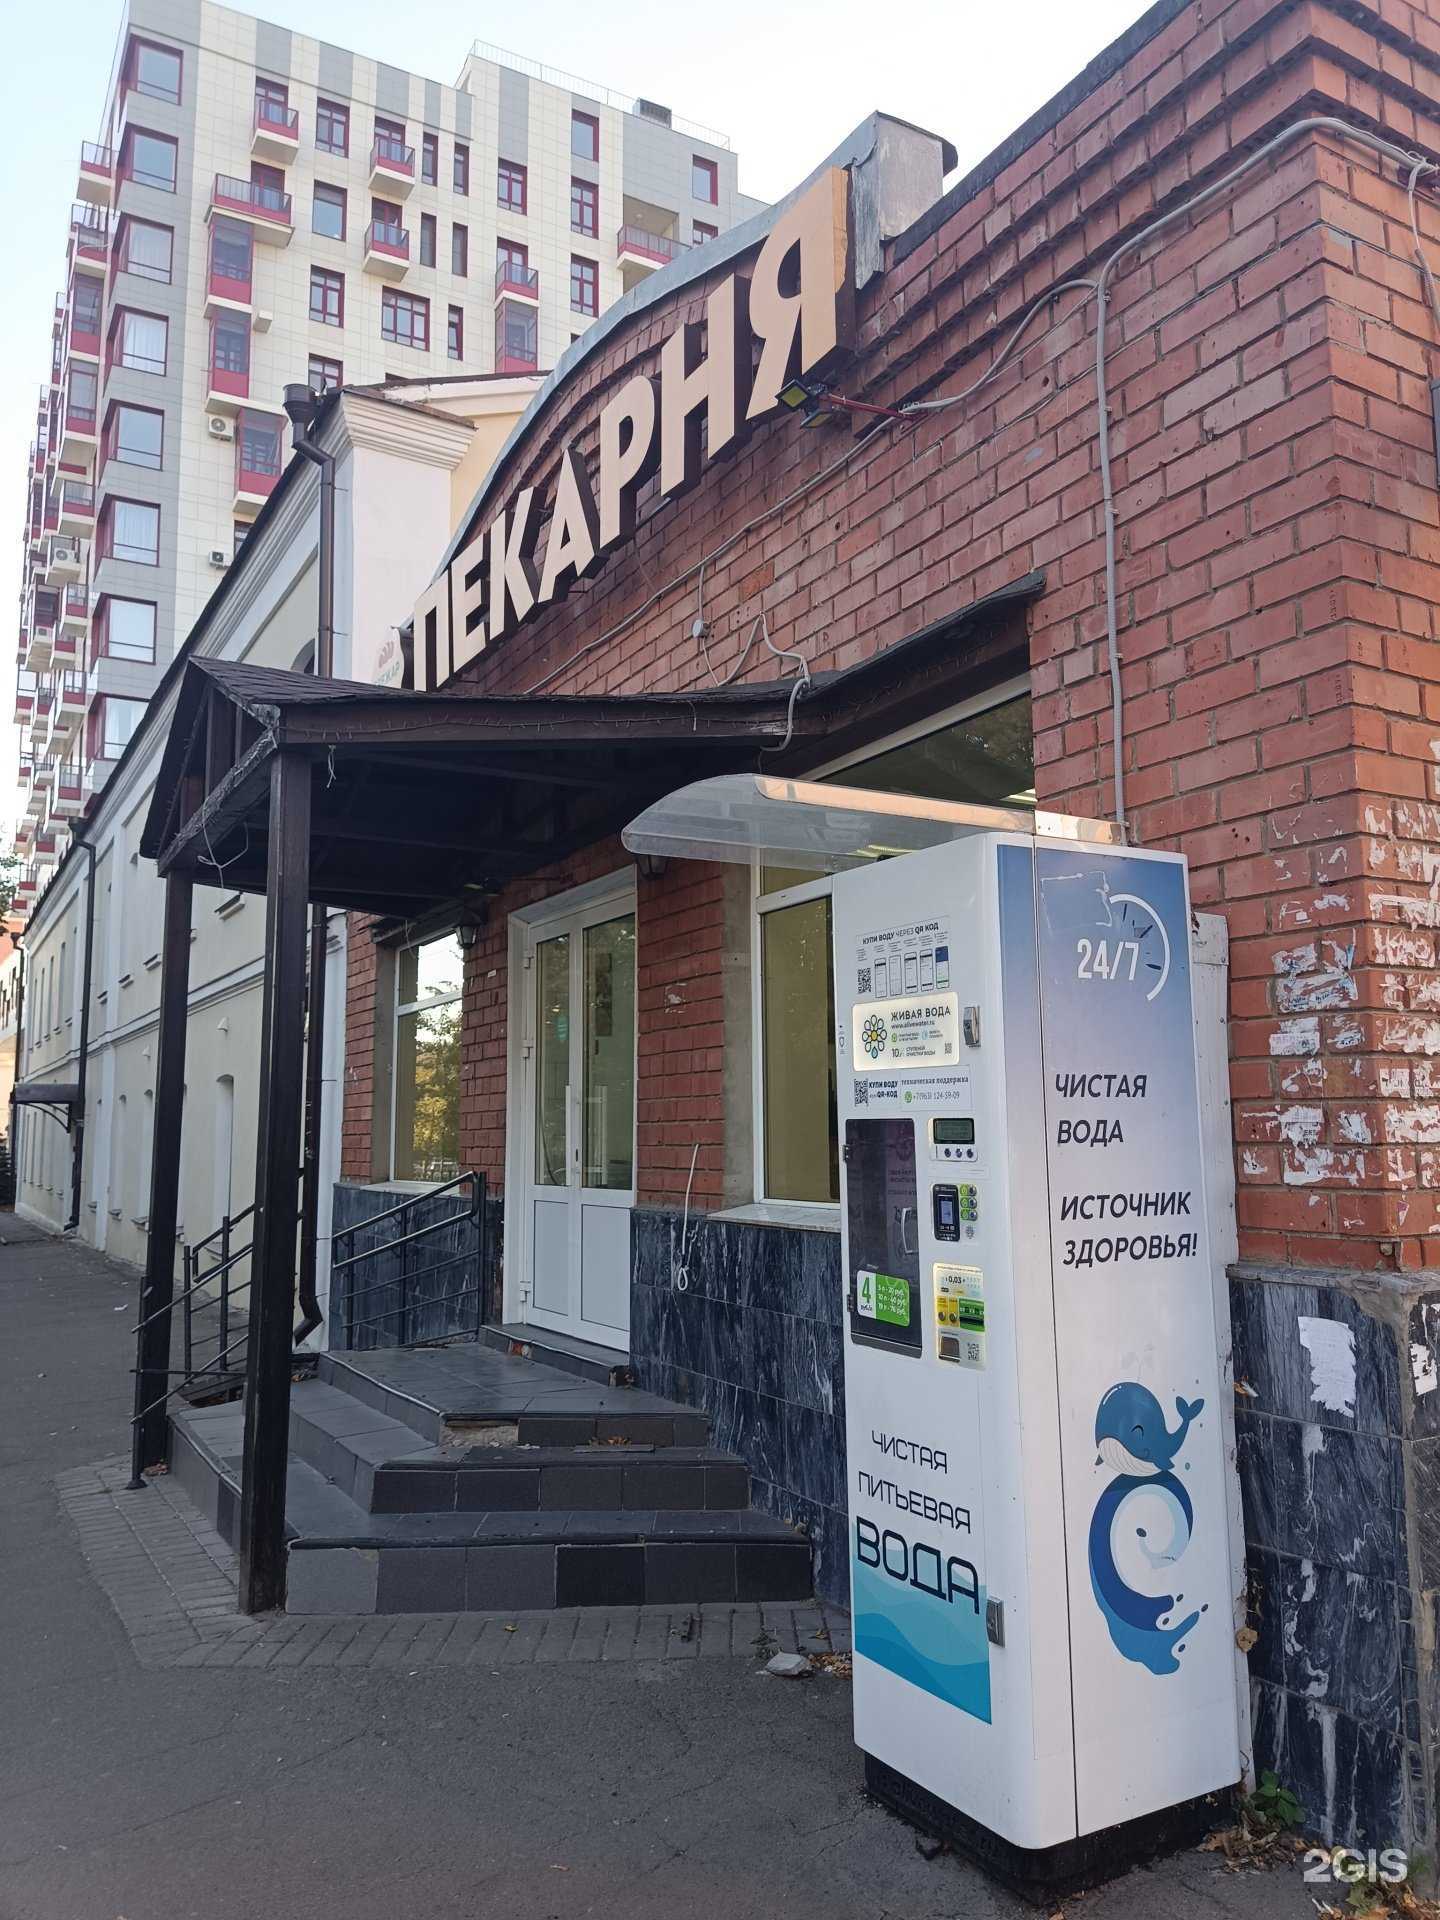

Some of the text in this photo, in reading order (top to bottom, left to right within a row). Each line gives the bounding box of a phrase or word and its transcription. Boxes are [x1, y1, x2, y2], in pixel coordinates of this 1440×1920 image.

[414, 167, 850, 692] ПЕКАРНЯ
[878, 932, 895, 942] ВОДУ
[924, 922, 939, 932] КОД
[1077, 938, 1139, 980] 24/7
[891, 1006, 951, 1021] ЖИВАЯ ВОДА
[883, 1080, 898, 1088] ВОДУ
[1056, 1074, 1147, 1098] ЧИСТАЯ
[1057, 1119, 1124, 1147] ВОДА
[1061, 1191, 1192, 1221] ИСТОЧНИК
[1063, 1233, 1198, 1269] ЗДОРОВЬЯ!
[862, 1276, 871, 1303] 4
[871, 1430, 948, 1474] ЧИСТАЯ
[859, 1471, 971, 1534] ПИТЬЕВАЯ
[856, 1515, 980, 1615] ВОДА
